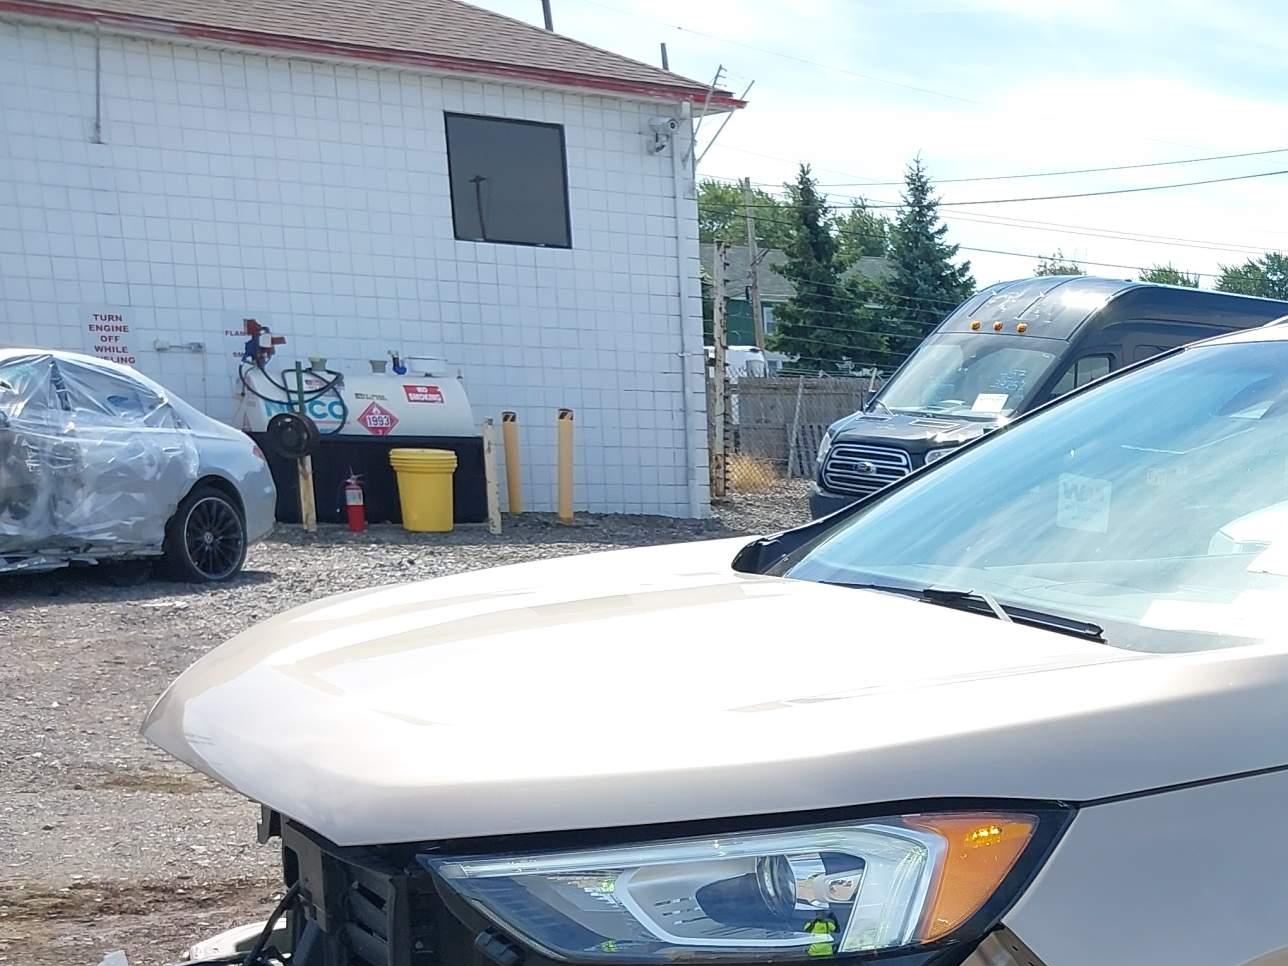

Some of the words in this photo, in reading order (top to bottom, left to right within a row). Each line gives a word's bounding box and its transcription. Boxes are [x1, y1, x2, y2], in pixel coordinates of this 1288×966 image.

[92, 313, 122, 322] TURN
[88, 324, 129, 333] ENGINE
[100, 335, 120, 343] OFF
[94, 345, 129, 354] WHILE
[96, 355, 136, 364] ELING
[367, 416, 390, 427] 1993
